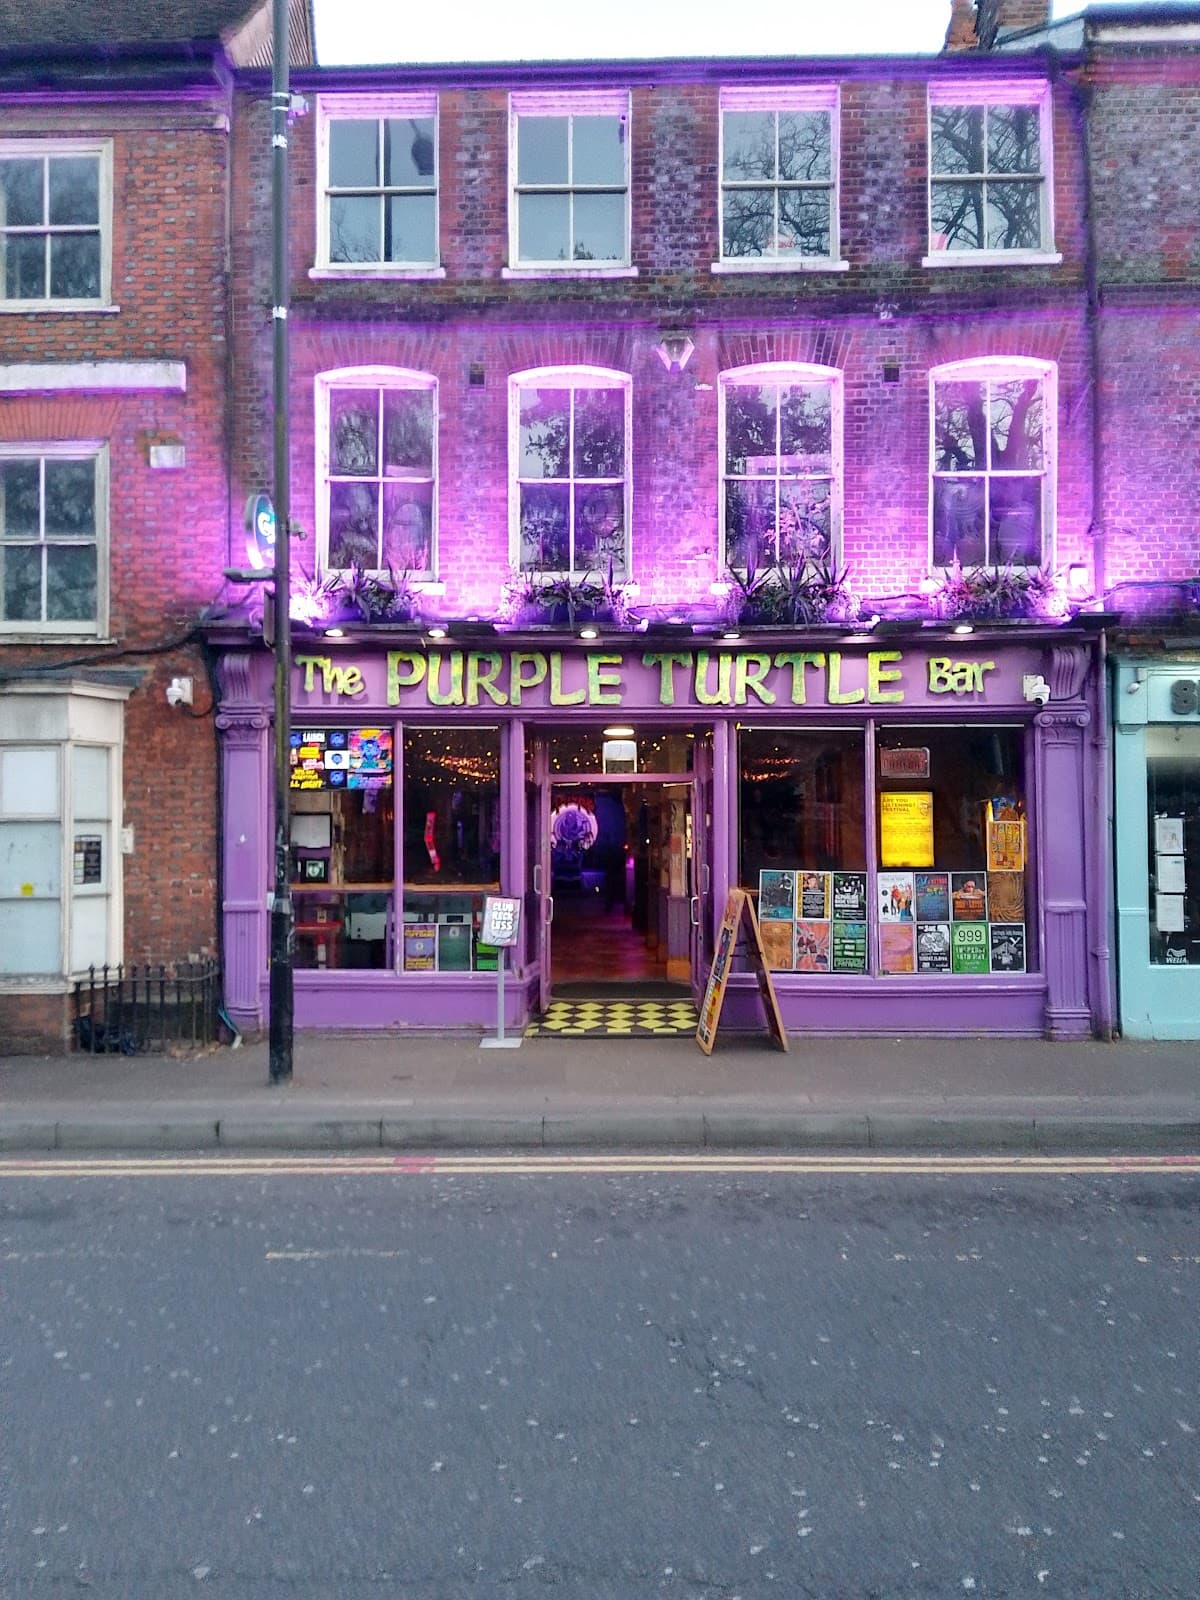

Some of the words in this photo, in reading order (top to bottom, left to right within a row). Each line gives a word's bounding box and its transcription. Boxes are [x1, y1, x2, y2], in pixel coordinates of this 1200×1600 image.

[295, 655, 365, 695] The
[387, 651, 623, 706] PURPLE
[642, 651, 905, 706] TURTLE
[928, 657, 996, 693] Bar
[493, 902, 514, 911] CLUB
[491, 920, 513, 930] LESS
[958, 929, 982, 942] 999
